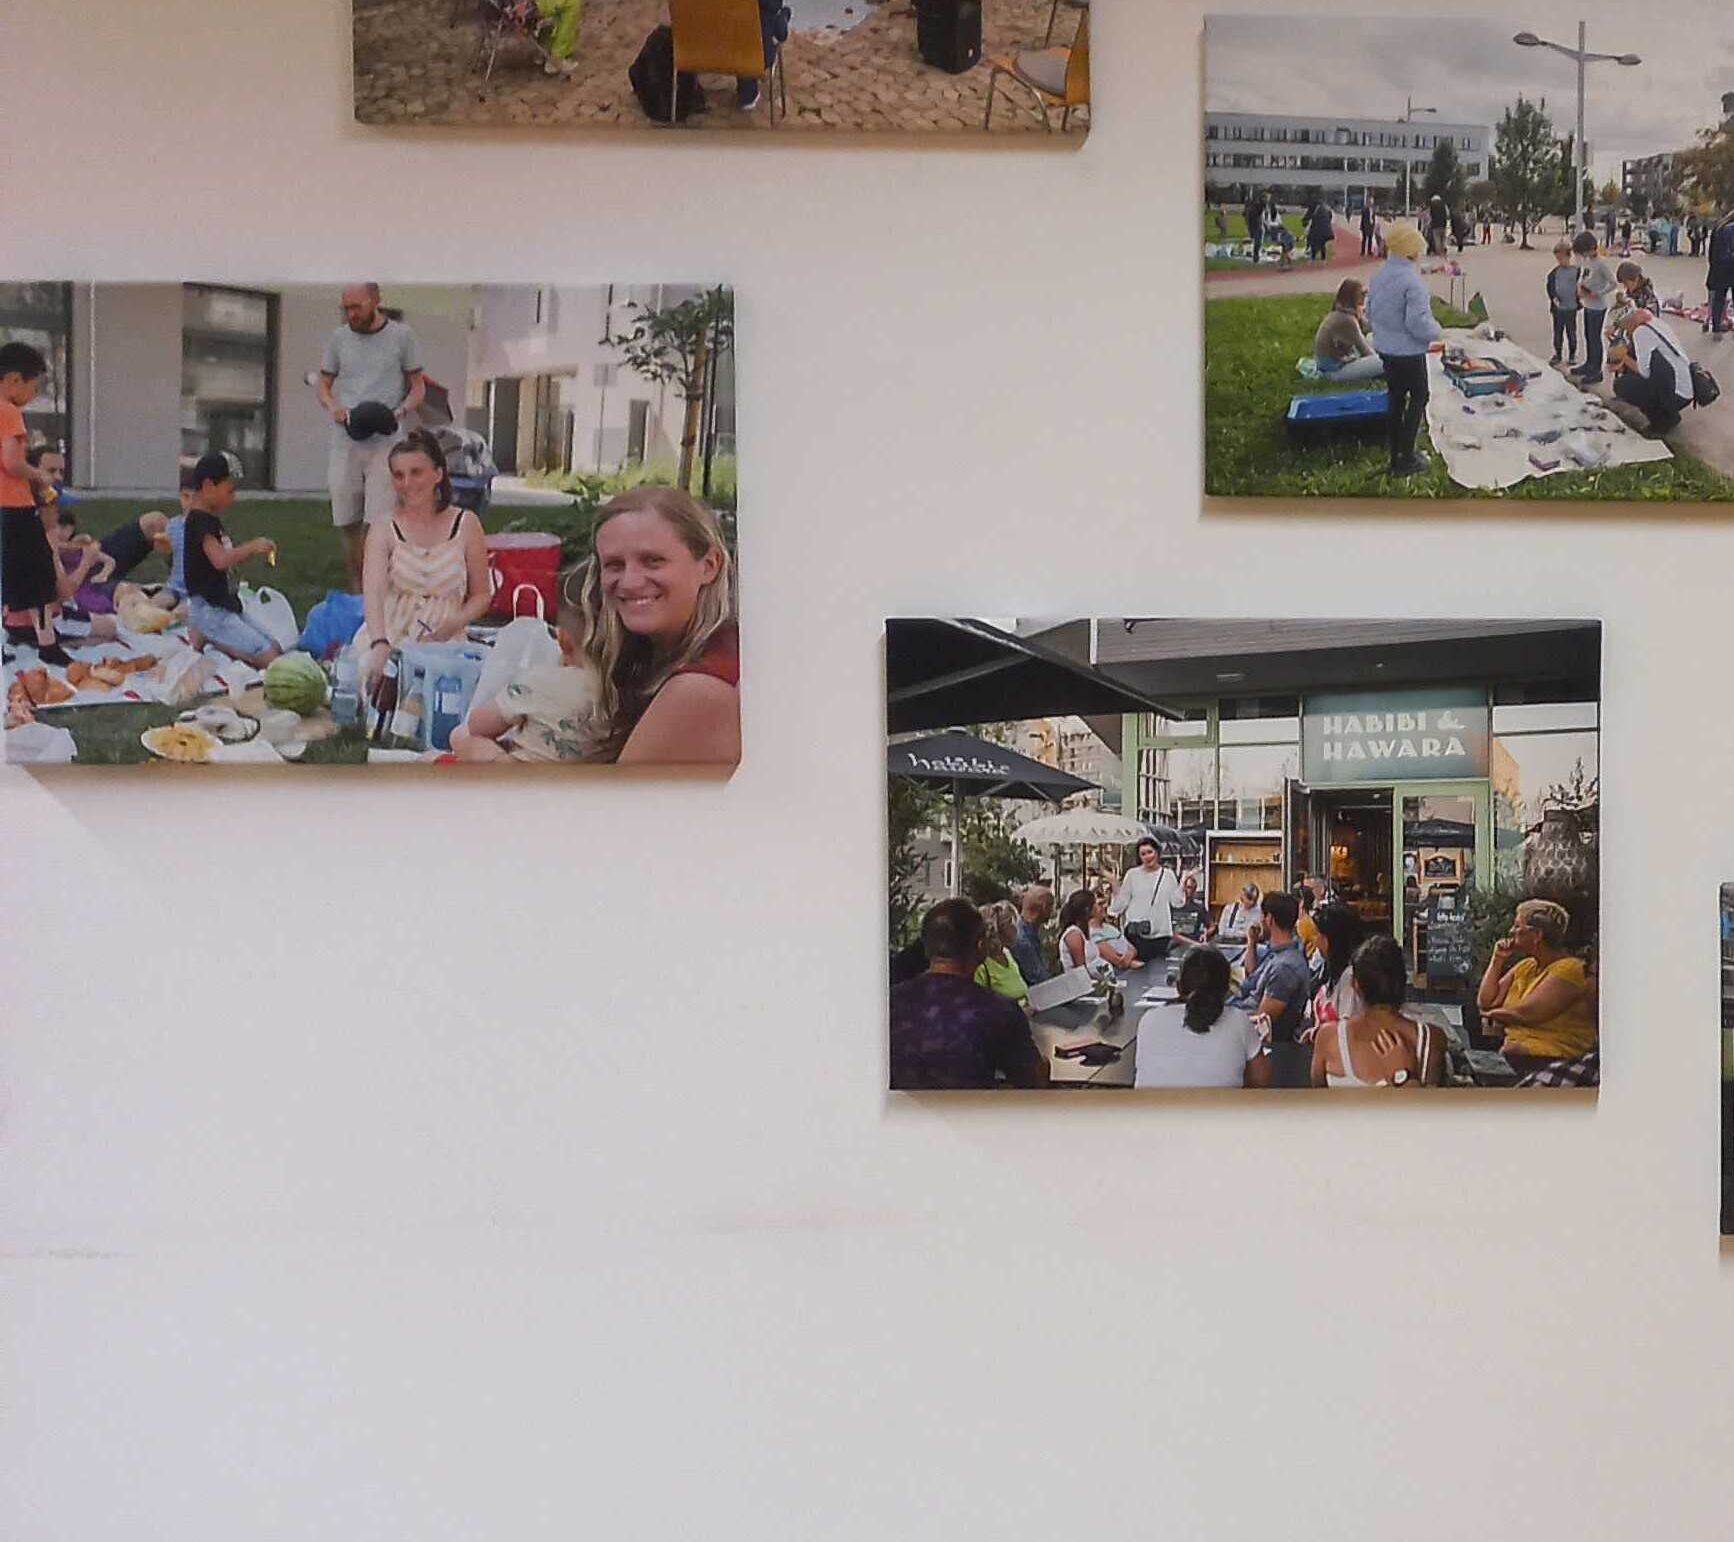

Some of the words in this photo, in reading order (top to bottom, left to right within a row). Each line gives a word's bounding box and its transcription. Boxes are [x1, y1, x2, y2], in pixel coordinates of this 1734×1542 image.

[1323, 712, 1427, 735] HABIBI
[1437, 710, 1466, 731] &
[1323, 737, 1466, 760] HAWARA
